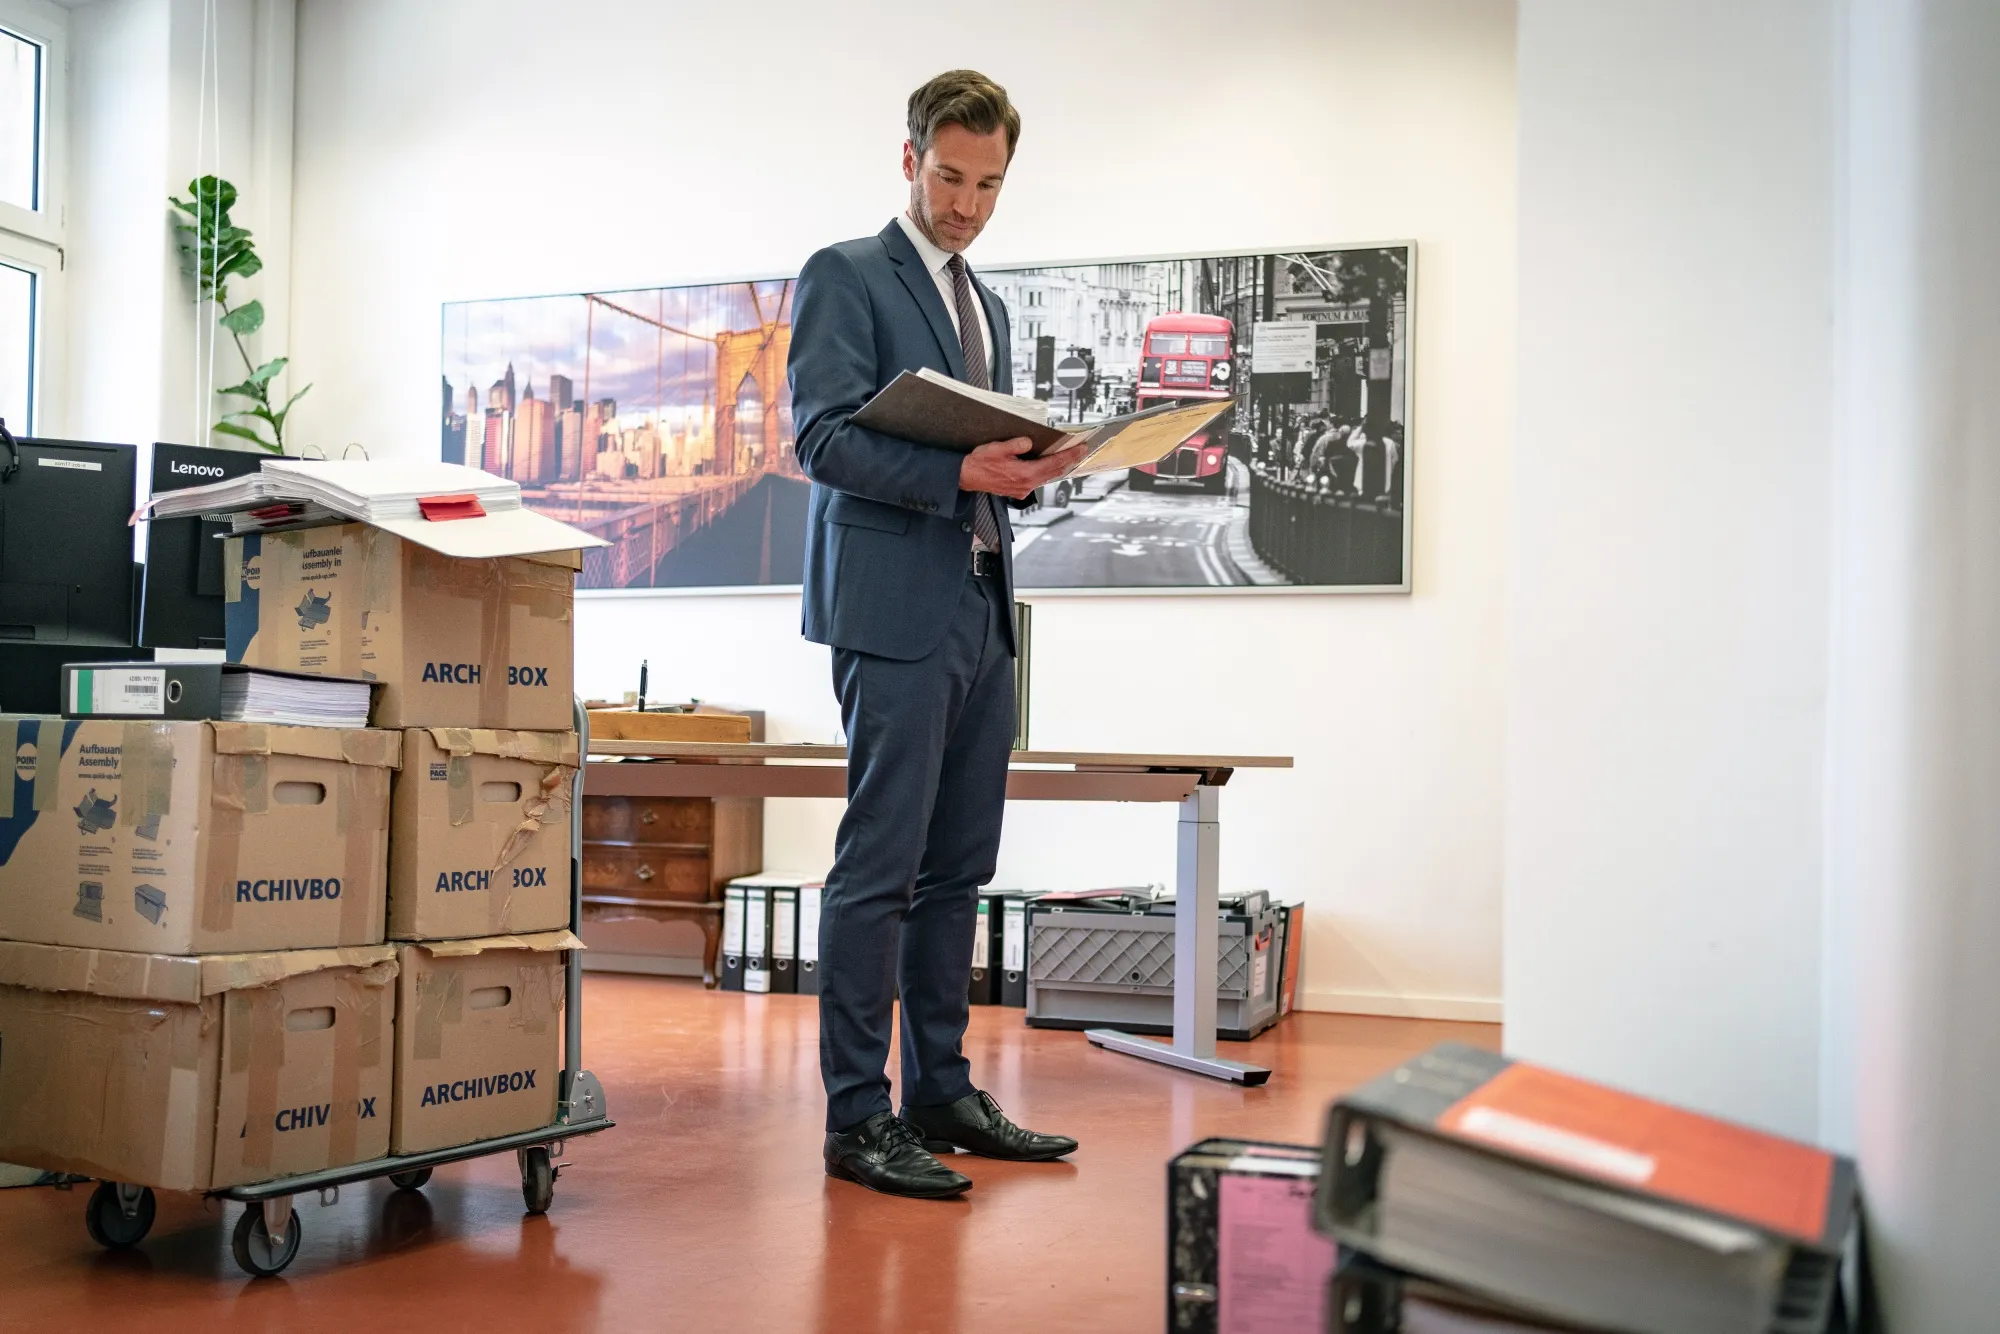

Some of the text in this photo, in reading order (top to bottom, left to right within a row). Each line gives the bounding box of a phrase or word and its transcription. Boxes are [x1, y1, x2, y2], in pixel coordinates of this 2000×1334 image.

[171, 460, 225, 478] Lenovo
[422, 662, 548, 687] ARCHBOX
[79, 756, 119, 769] Assembly
[236, 878, 344, 902] RCHIVBO
[435, 867, 547, 893] ARCHBOX
[420, 1069, 537, 1108] ARCHIVBOX
